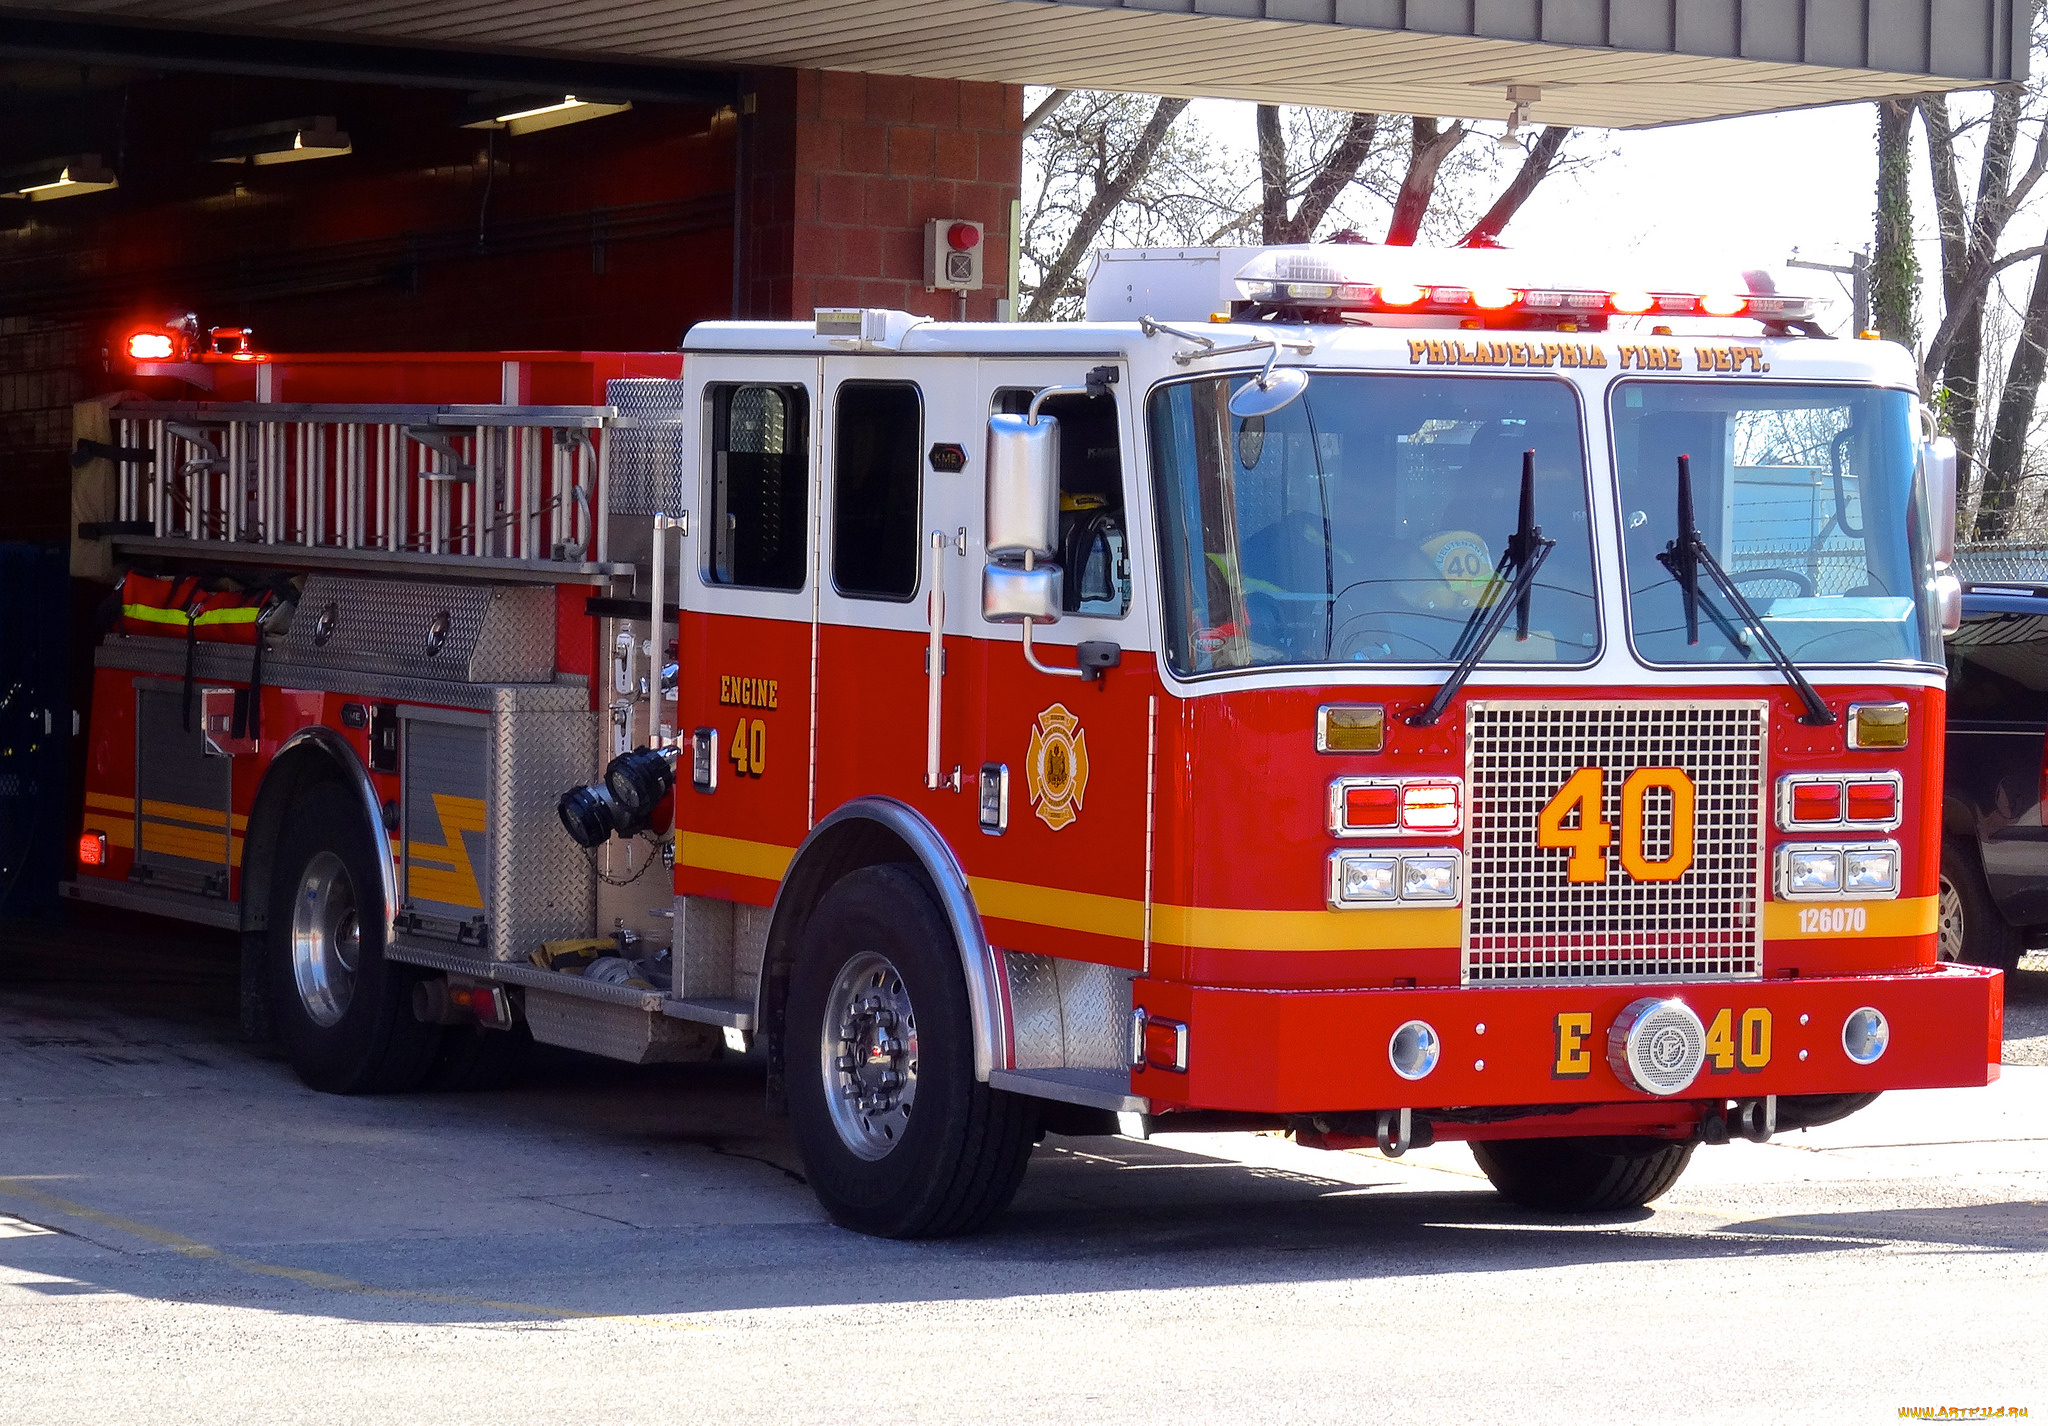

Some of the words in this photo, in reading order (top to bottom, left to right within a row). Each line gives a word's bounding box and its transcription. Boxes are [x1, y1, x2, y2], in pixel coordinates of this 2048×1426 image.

[1407, 339, 1607, 369] PHILADELPHIA
[1617, 344, 1682, 371] FIRE
[1694, 346, 1771, 372] DEPT.
[934, 453, 957, 464] KME
[1447, 553, 1481, 577] 40
[720, 675, 778, 711] ENGINE
[730, 717, 766, 776] 40
[1537, 766, 1695, 882] 40
[1798, 907, 1866, 932] 126070
[1551, 1012, 1592, 1079] E
[1705, 1007, 1773, 1073] 40
